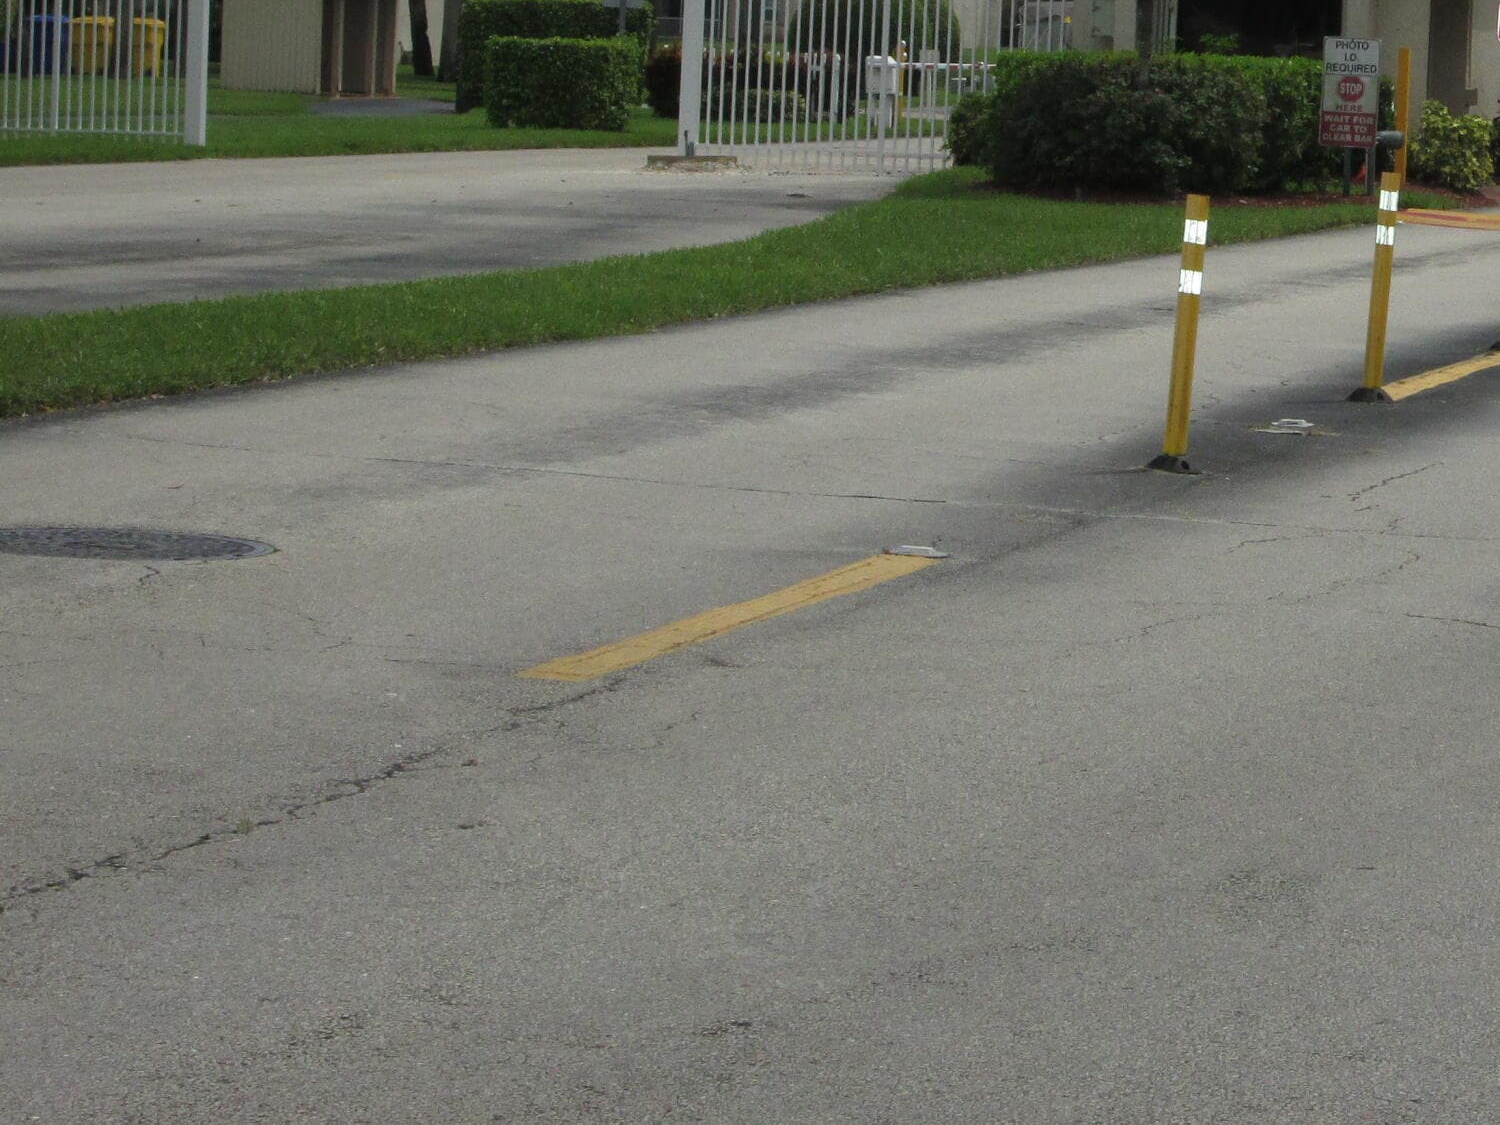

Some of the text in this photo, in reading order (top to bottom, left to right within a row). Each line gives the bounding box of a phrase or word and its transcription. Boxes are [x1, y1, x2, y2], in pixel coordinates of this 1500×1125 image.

[1335, 40, 1370, 51] PHOTO
[1325, 62, 1377, 74] REQUIRED
[1339, 82, 1362, 95] STOP
[1336, 104, 1363, 112] HERE
[1324, 114, 1374, 124] WAIT FOR
[1330, 124, 1367, 133] CAR TO
